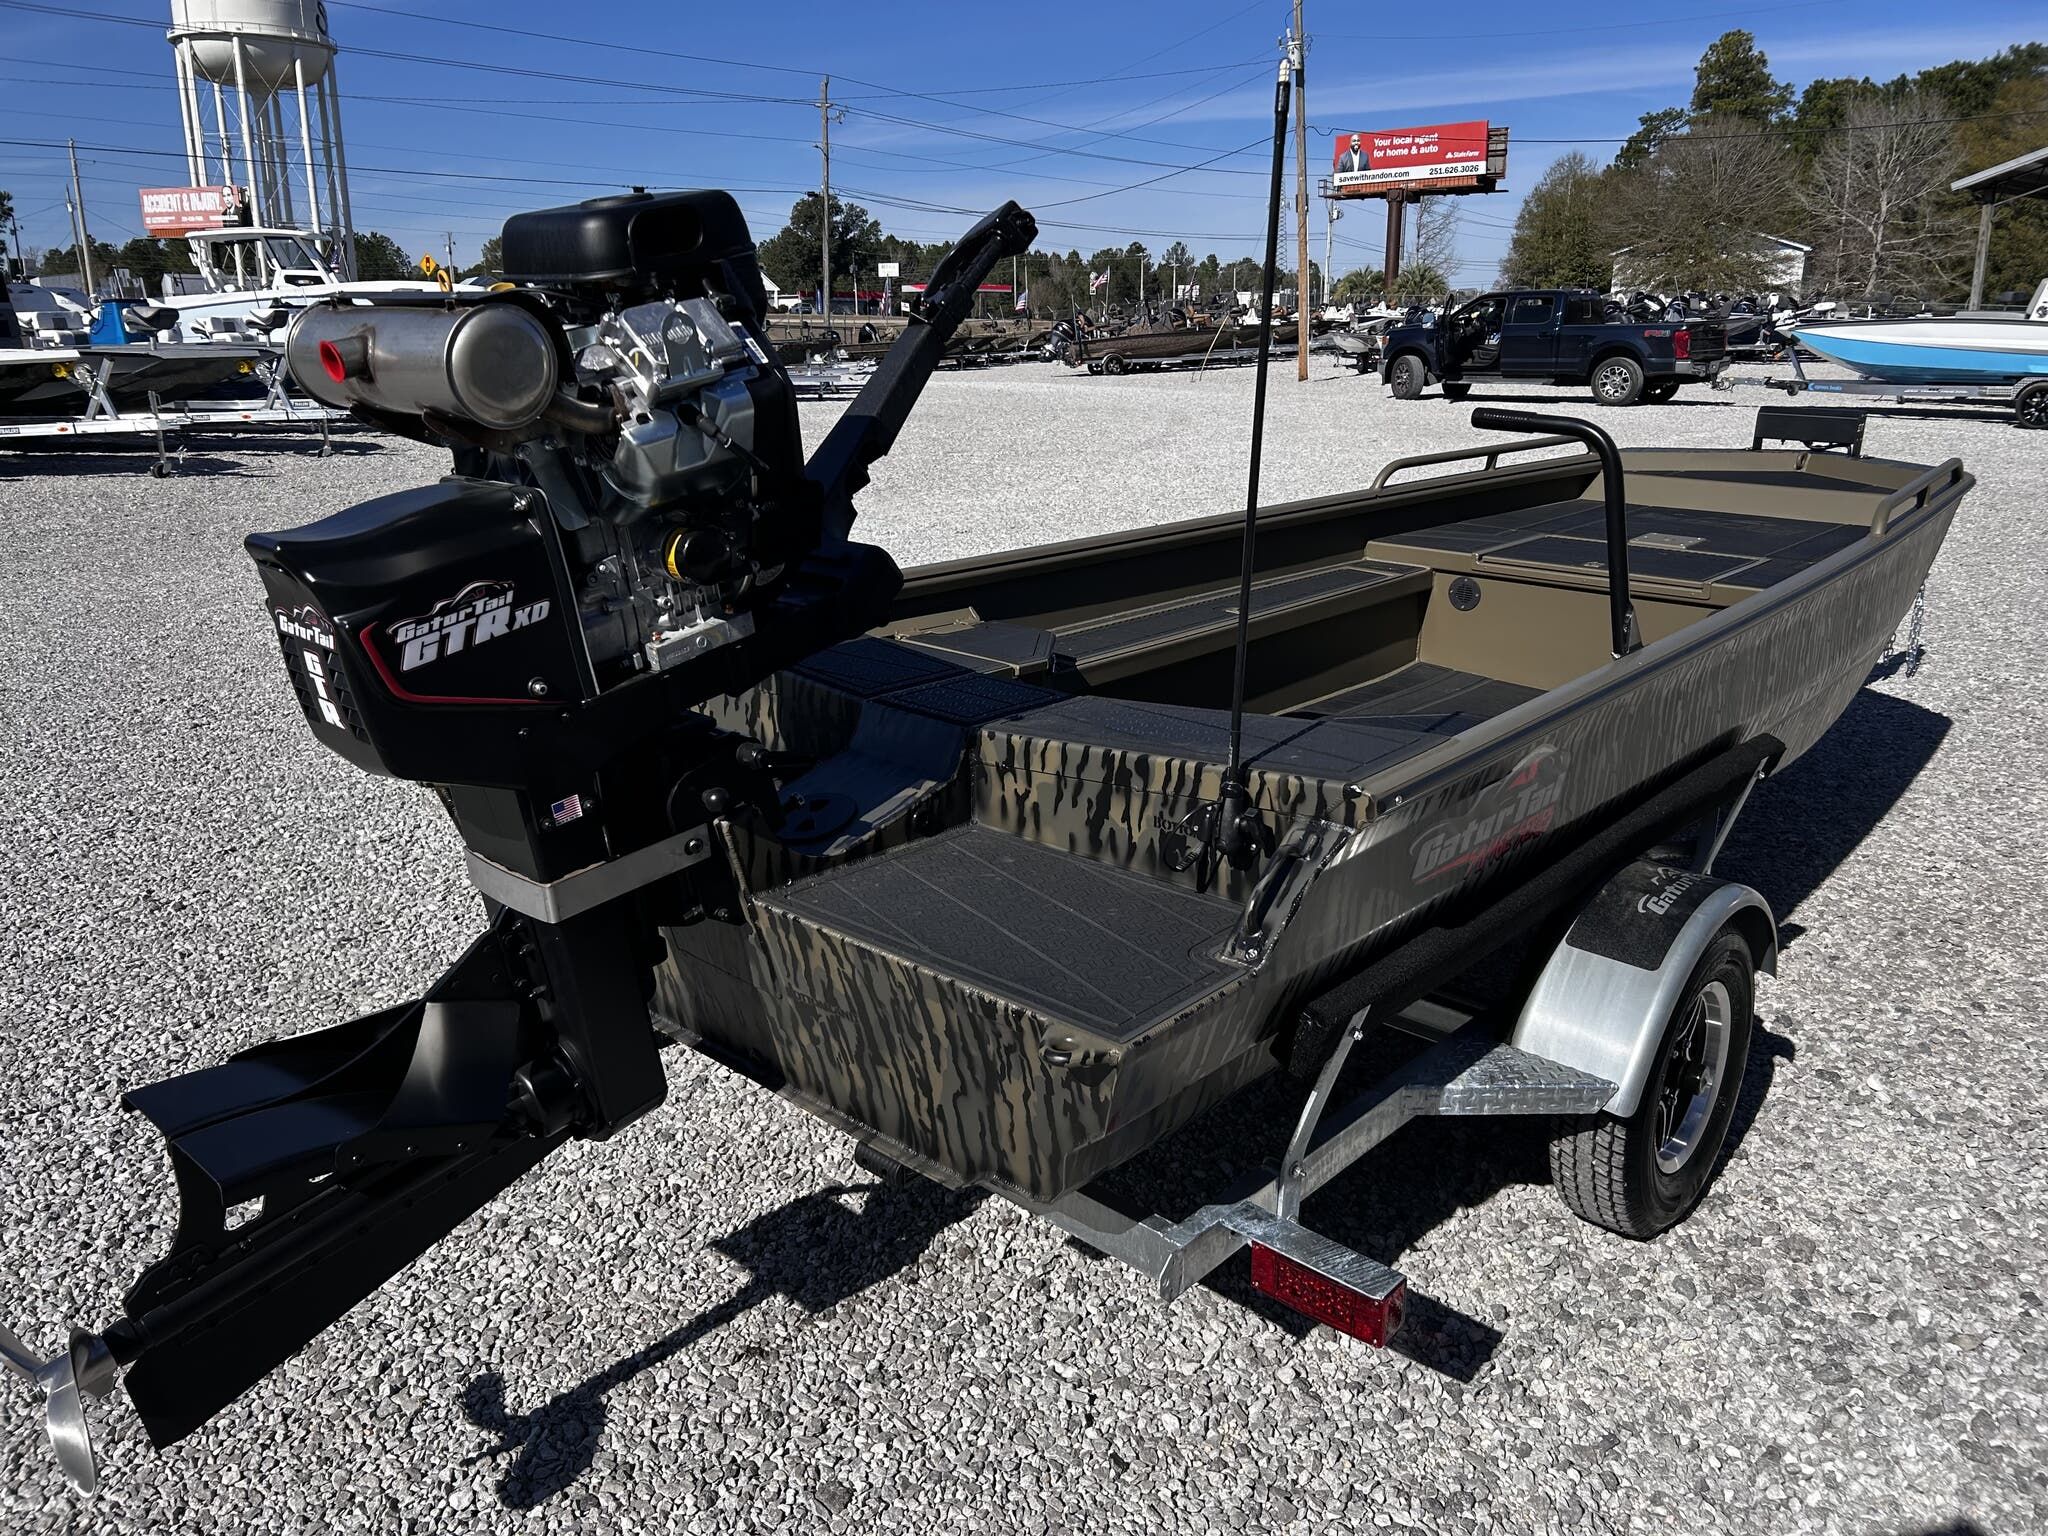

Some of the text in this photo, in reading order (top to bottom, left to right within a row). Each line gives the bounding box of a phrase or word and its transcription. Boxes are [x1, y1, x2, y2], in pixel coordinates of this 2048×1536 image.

[1373, 133, 1438, 147] Your local agent
[1373, 144, 1438, 158] for home & auto
[1338, 170, 1410, 183] savewithrandon.com
[1429, 165, 1480, 176] 251.626.3026
[142, 191, 223, 213] ACCIDENT & INJURY.
[396, 590, 514, 644] GatorTail
[278, 614, 335, 650] GatorTail
[401, 601, 550, 673] GTR XD
[303, 650, 346, 730] GTR
[1411, 771, 1568, 881] GatorTail
